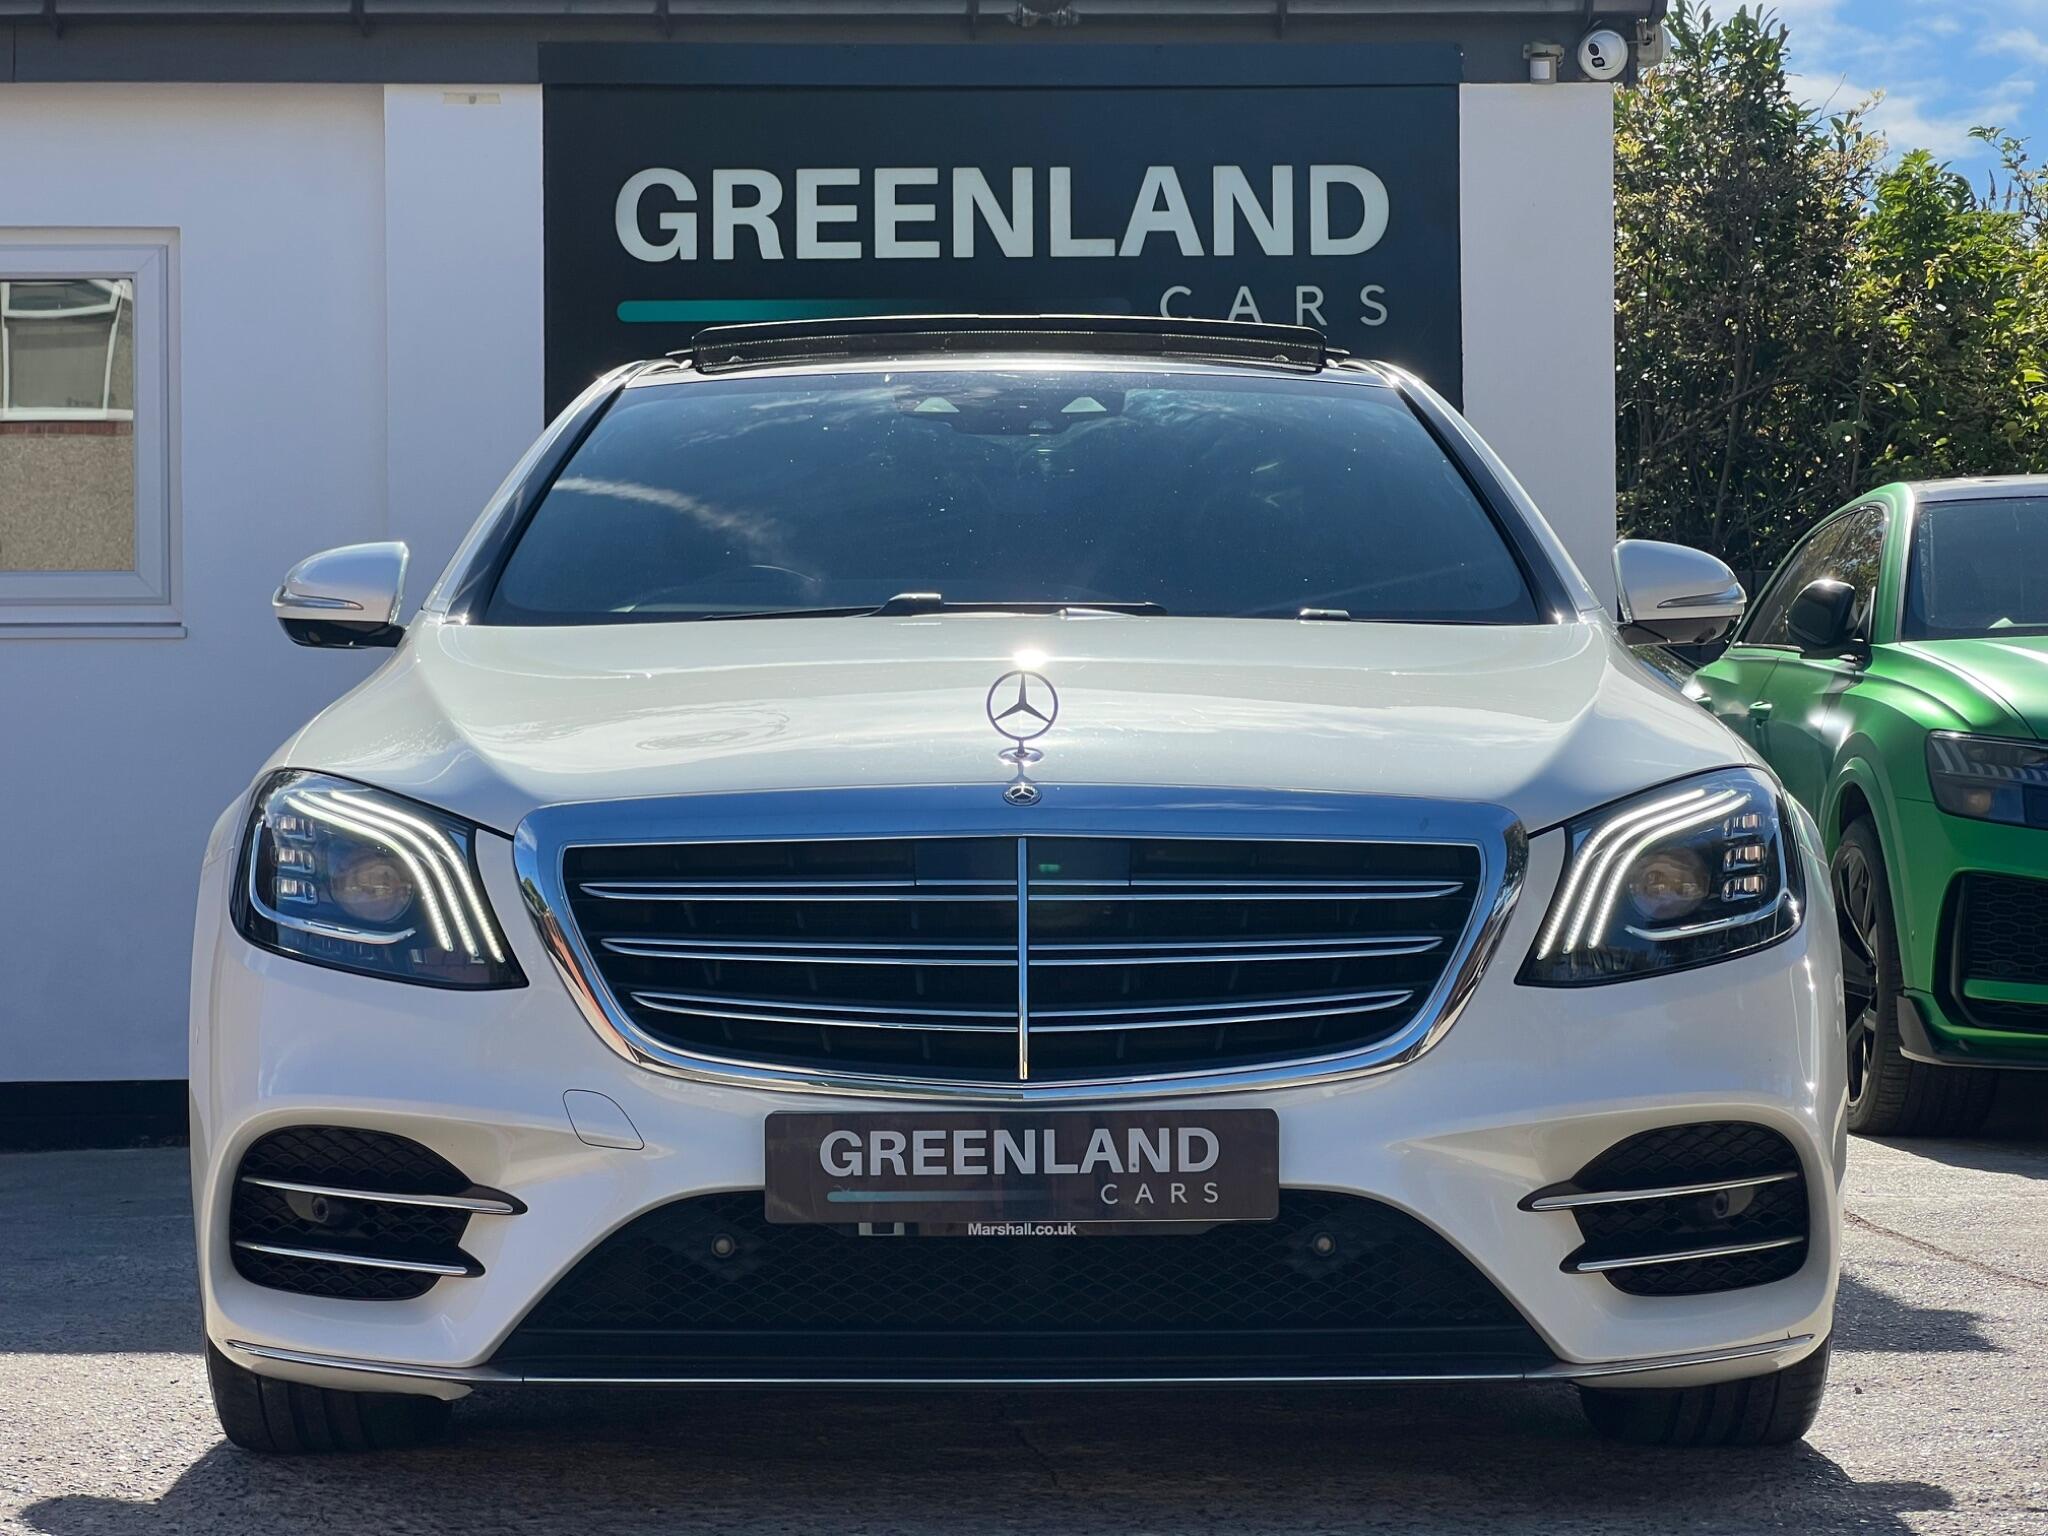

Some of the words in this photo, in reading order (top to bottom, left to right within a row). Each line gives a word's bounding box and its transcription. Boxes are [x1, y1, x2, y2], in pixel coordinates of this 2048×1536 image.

[615, 164, 1390, 262] GREENLAND
[1159, 284, 1388, 326] CARS
[819, 1127, 1220, 1177] GREENLAND
[1100, 1182, 1219, 1205] CARS
[967, 1222, 1077, 1236] Marshall.co.uk
